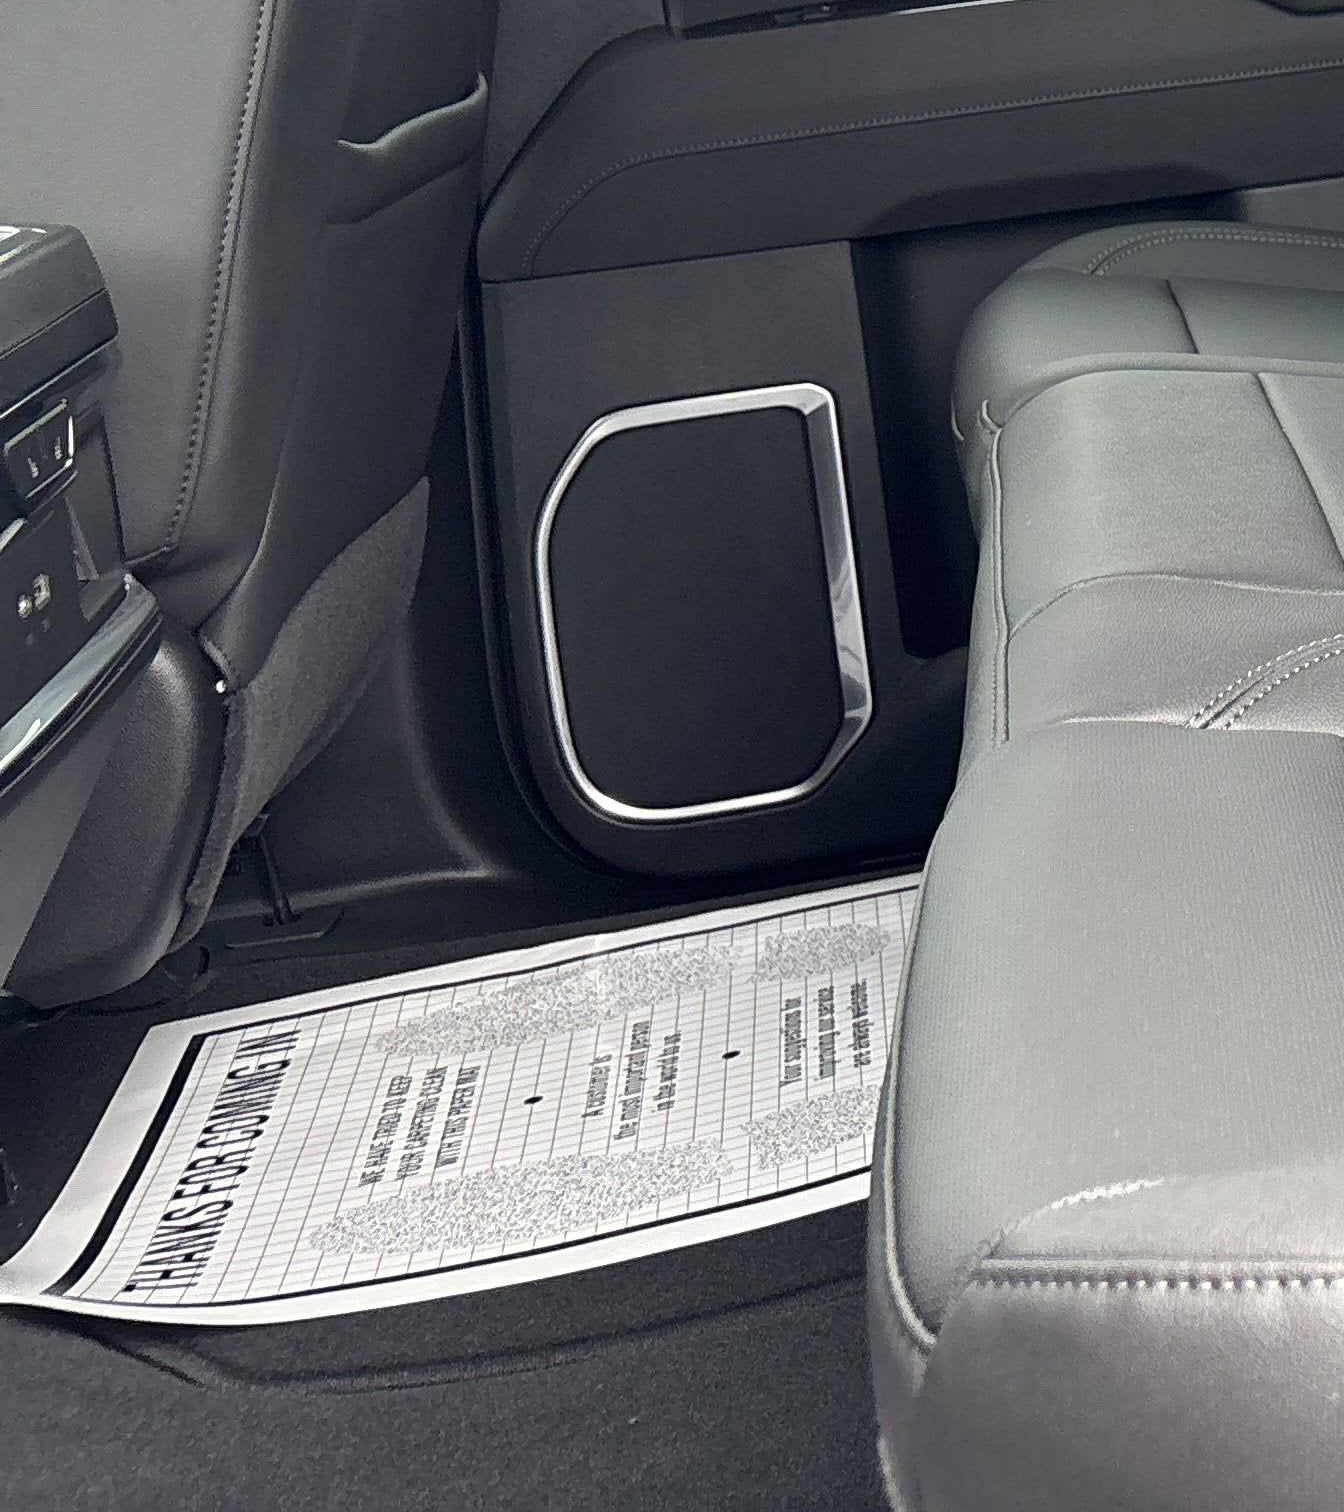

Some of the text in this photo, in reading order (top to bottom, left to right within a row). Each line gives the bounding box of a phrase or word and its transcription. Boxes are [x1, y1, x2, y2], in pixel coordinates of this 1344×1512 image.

[779, 996, 808, 1088] Your suggestions for
[812, 985, 842, 1081] improving our service
[847, 1018, 875, 1050] always
[853, 1050, 872, 1068] are
[585, 1065, 611, 1108] customer
[613, 1020, 652, 1141] the most important person
[653, 1083, 676, 1101] the
[656, 1055, 679, 1084] world
[358, 1075, 413, 1187] WE HAVE TRIED TO KEEP
[394, 1066, 448, 1182] YOUR CARPETING CLEAN
[435, 1065, 481, 1168] WITH THIS PAPER MAT
[581, 1107, 605, 1118] A
[650, 1099, 676, 1113] in
[121, 1029, 302, 1292] THANKS FOR COMING IN
